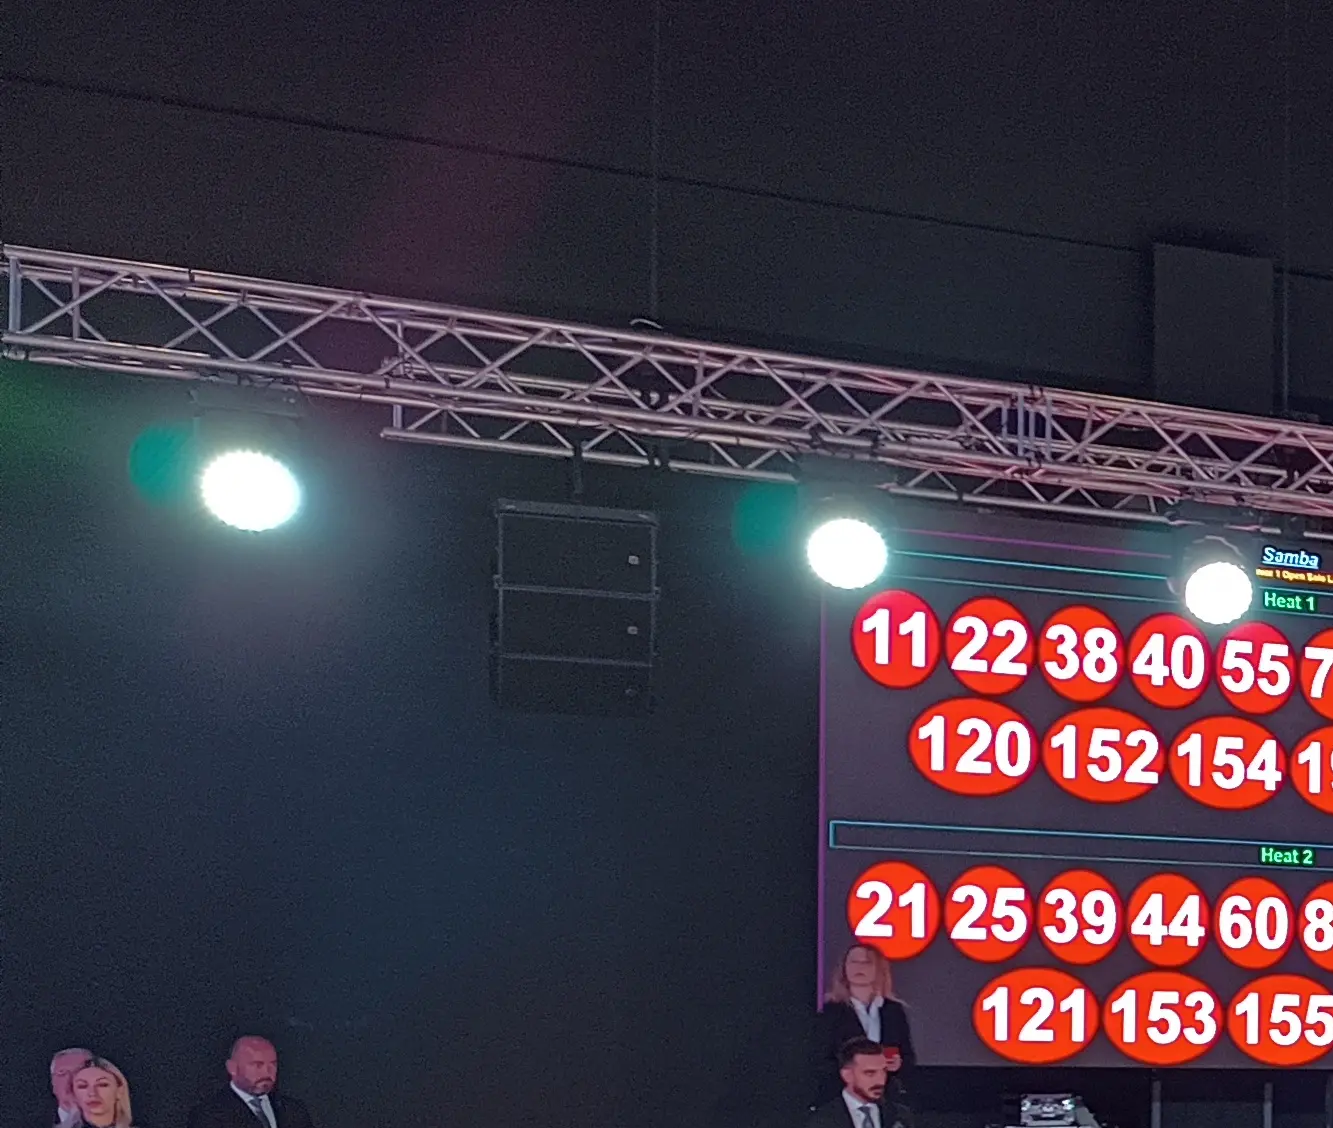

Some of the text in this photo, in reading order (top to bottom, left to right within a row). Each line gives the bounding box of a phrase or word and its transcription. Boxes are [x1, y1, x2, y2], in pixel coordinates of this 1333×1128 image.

[1262, 546, 1319, 568] Samba
[1264, 591, 1315, 611] Heat 1
[862, 608, 926, 668] 11
[950, 615, 1028, 676] 22
[1044, 623, 1118, 683] 38
[1132, 633, 1205, 690] 40
[1221, 639, 1291, 696] 55
[918, 715, 1031, 777] 120
[1050, 724, 1159, 784] 152
[1177, 733, 1282, 791] 154
[1261, 847, 1313, 865] Heat 2
[854, 880, 926, 938] 21
[950, 884, 1027, 942] 25
[1043, 888, 1117, 945] 39
[1130, 893, 1206, 947] 44
[1219, 895, 1289, 950] 60
[982, 986, 1085, 1043] 121
[1111, 989, 1217, 1045] 153
